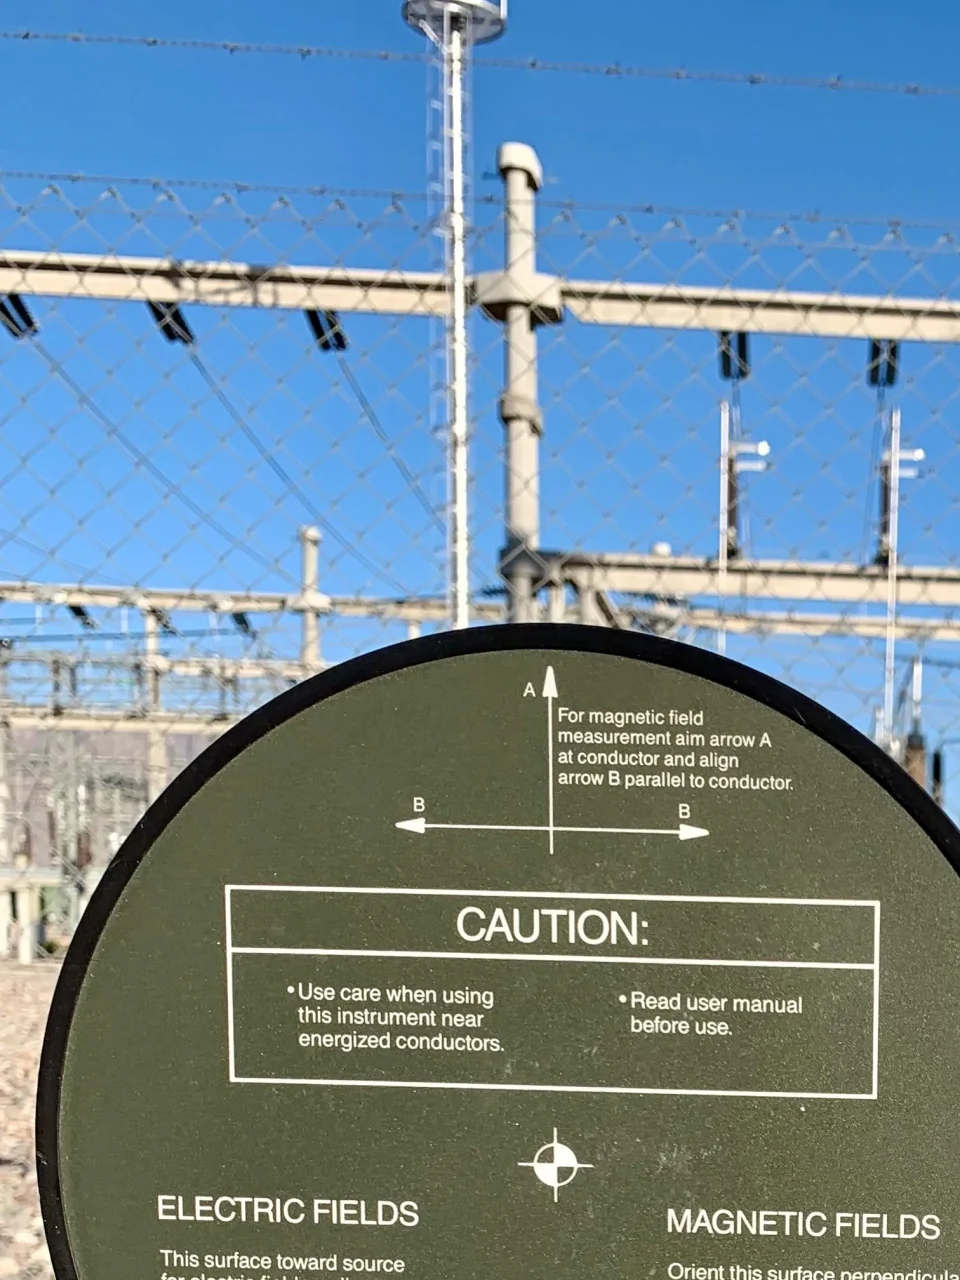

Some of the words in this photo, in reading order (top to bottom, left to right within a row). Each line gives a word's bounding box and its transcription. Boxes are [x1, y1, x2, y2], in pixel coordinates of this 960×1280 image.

[522, 681, 536, 698] A
[558, 706, 585, 724] For
[588, 707, 665, 728] magnetic
[668, 709, 704, 726] field
[557, 730, 672, 746] measurement
[675, 733, 705, 747] aim
[709, 734, 756, 748] arrow
[758, 732, 772, 748] A
[557, 749, 574, 764] at
[577, 749, 661, 767] conductor
[663, 751, 695, 767] and
[699, 752, 739, 772] align
[557, 772, 605, 786] arrow
[608, 770, 621, 786] B
[624, 771, 686, 790] parallel
[689, 773, 706, 789] to
[708, 773, 794, 791] conductor.
[413, 796, 426, 812] B
[678, 803, 691, 819] B
[456, 906, 649, 946] CAUTION:
[298, 982, 336, 1001] Use
[339, 987, 382, 1002] care
[385, 984, 437, 1003] when
[442, 986, 494, 1010] using
[630, 991, 681, 1011] Read
[686, 997, 729, 1012] user
[732, 996, 803, 1014] manual
[297, 1005, 332, 1024] this
[337, 1006, 437, 1027] instrument
[441, 1013, 485, 1028] near
[630, 1015, 690, 1035] before
[695, 1021, 733, 1036] use.
[298, 1030, 391, 1053] energized
[395, 1032, 505, 1052] conductors.
[157, 1194, 306, 1224] ELECTRIC
[313, 1198, 420, 1227] FIELDS
[667, 1208, 828, 1237] MAGNETIC
[835, 1212, 941, 1240] FIELDS
[159, 1249, 200, 1268] This
[204, 1251, 272, 1270] surface
[276, 1253, 338, 1271] toward
[342, 1258, 406, 1273] source
[667, 1262, 725, 1280] Orient
